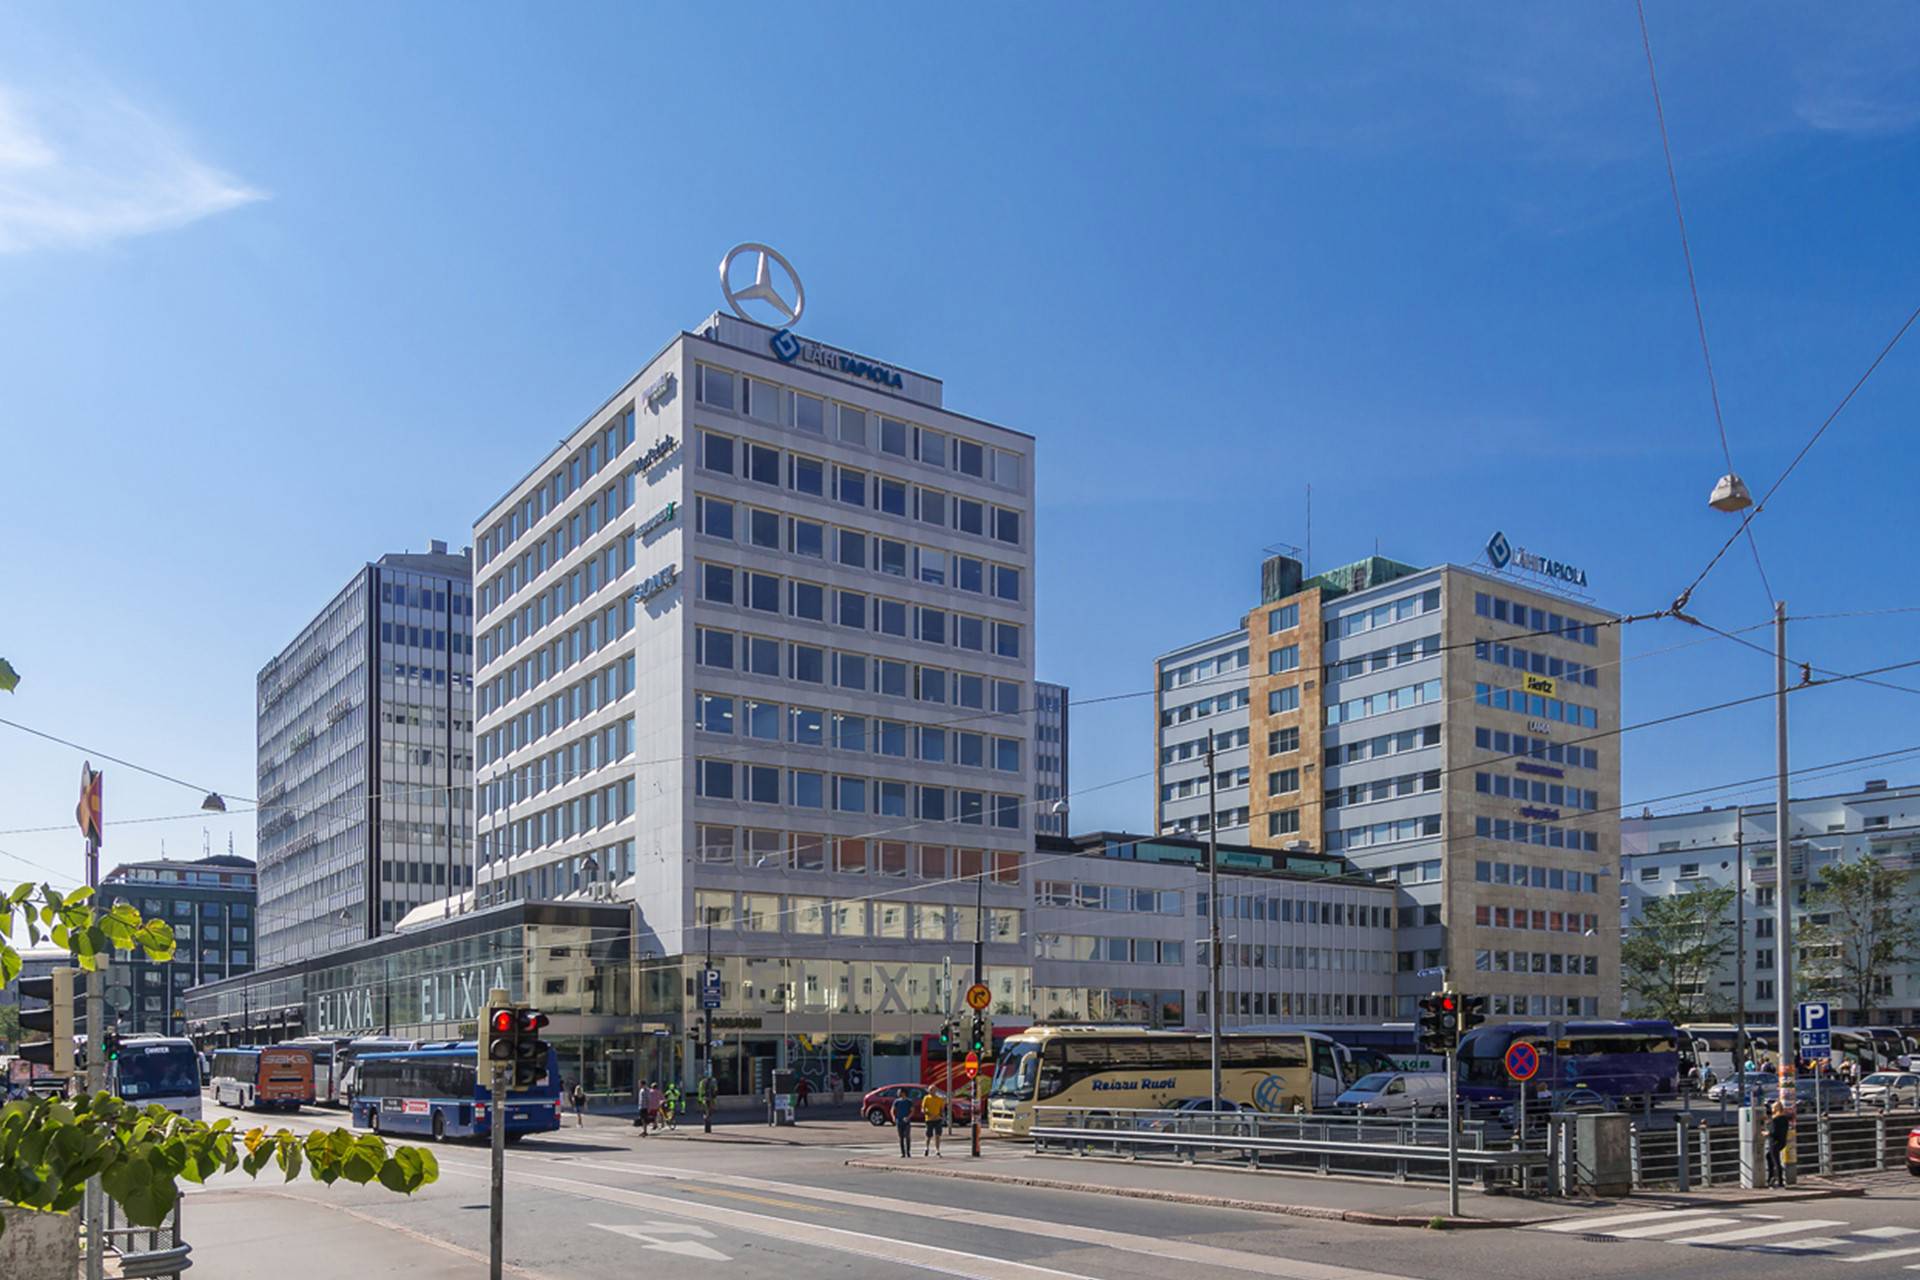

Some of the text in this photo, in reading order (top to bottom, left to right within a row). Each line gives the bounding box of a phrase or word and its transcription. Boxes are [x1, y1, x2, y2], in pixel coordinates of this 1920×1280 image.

[1527, 676, 1553, 694] Hertz
[707, 971, 719, 987] P
[319, 988, 374, 1032] ELIXIA
[1805, 1004, 1825, 1029] P
